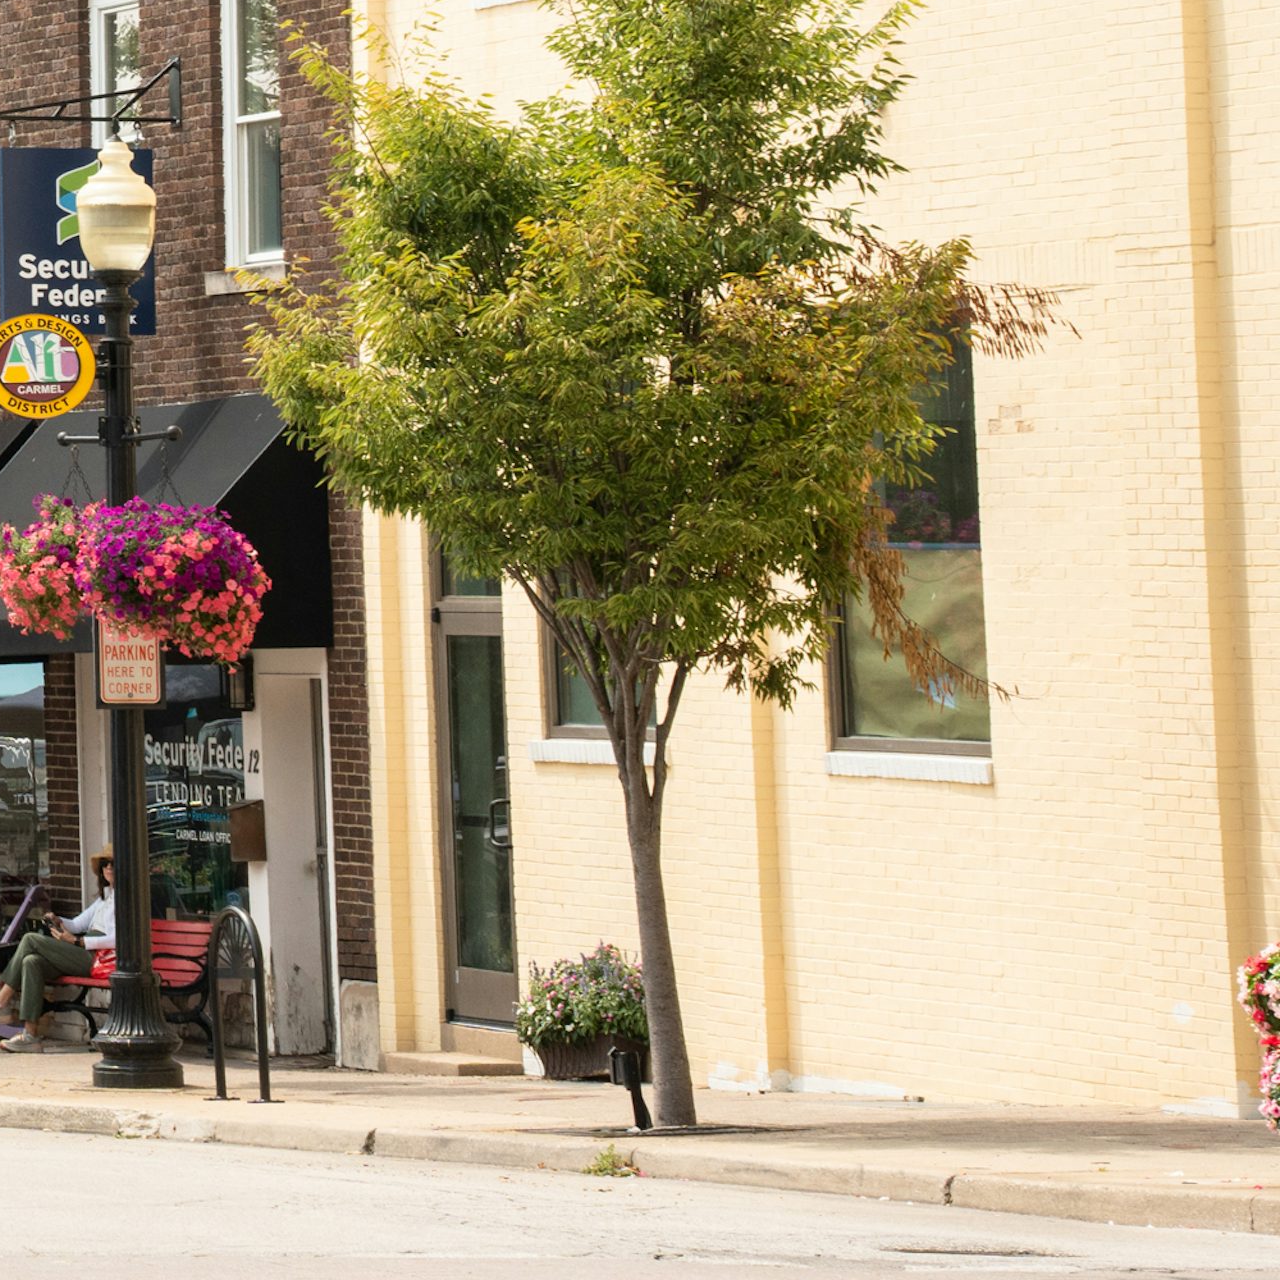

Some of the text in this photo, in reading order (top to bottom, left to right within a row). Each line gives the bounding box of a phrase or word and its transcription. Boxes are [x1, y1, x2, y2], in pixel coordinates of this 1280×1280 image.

[18, 253, 94, 279] Secu
[31, 283, 107, 307] Feder
[24, 318, 33, 328] &
[37, 318, 84, 348] DESIGN
[17, 384, 65, 395] CARMEL
[7, 397, 70, 415] DISTRICT
[105, 645, 154, 661] PARKING
[107, 666, 153, 678] HERE TO
[109, 682, 152, 694] CORNER
[144, 733, 243, 775] Security Fede
[155, 782, 242, 807] LENDING TEA
[176, 829, 231, 844] CARMEL LOAN OFFIC
